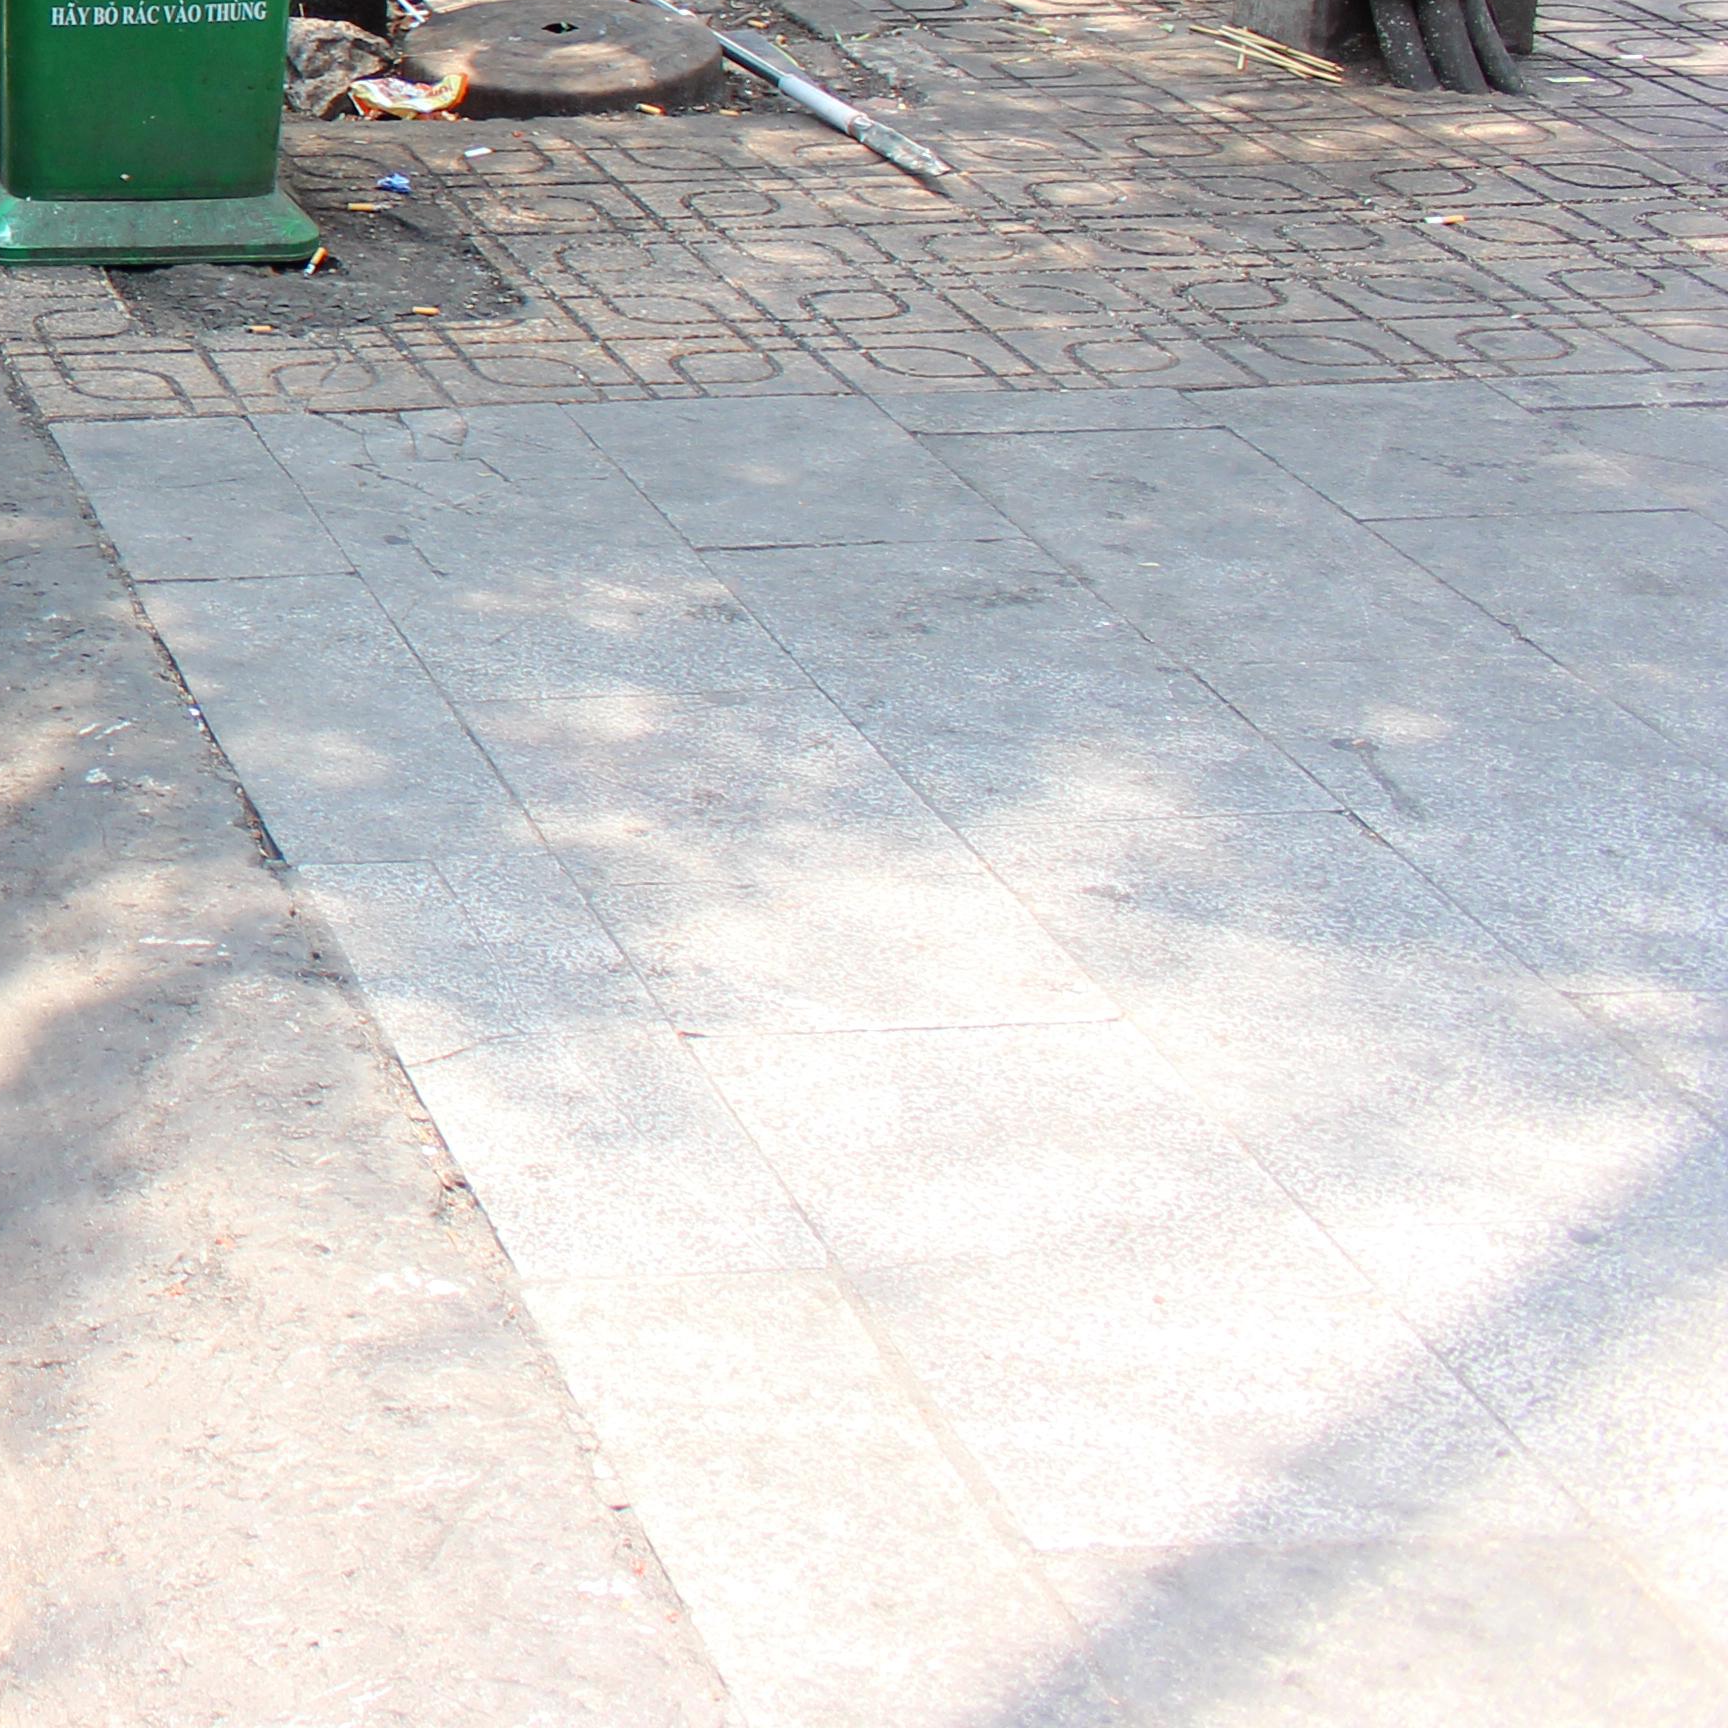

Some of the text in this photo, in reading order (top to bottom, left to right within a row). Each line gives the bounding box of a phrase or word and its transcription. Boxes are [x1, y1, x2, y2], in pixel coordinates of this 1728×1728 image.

[51, 1, 90, 27] HÃY
[94, 1, 119, 26] BỎ
[122, 0, 160, 25] RÁC
[163, 0, 202, 24] VÀO
